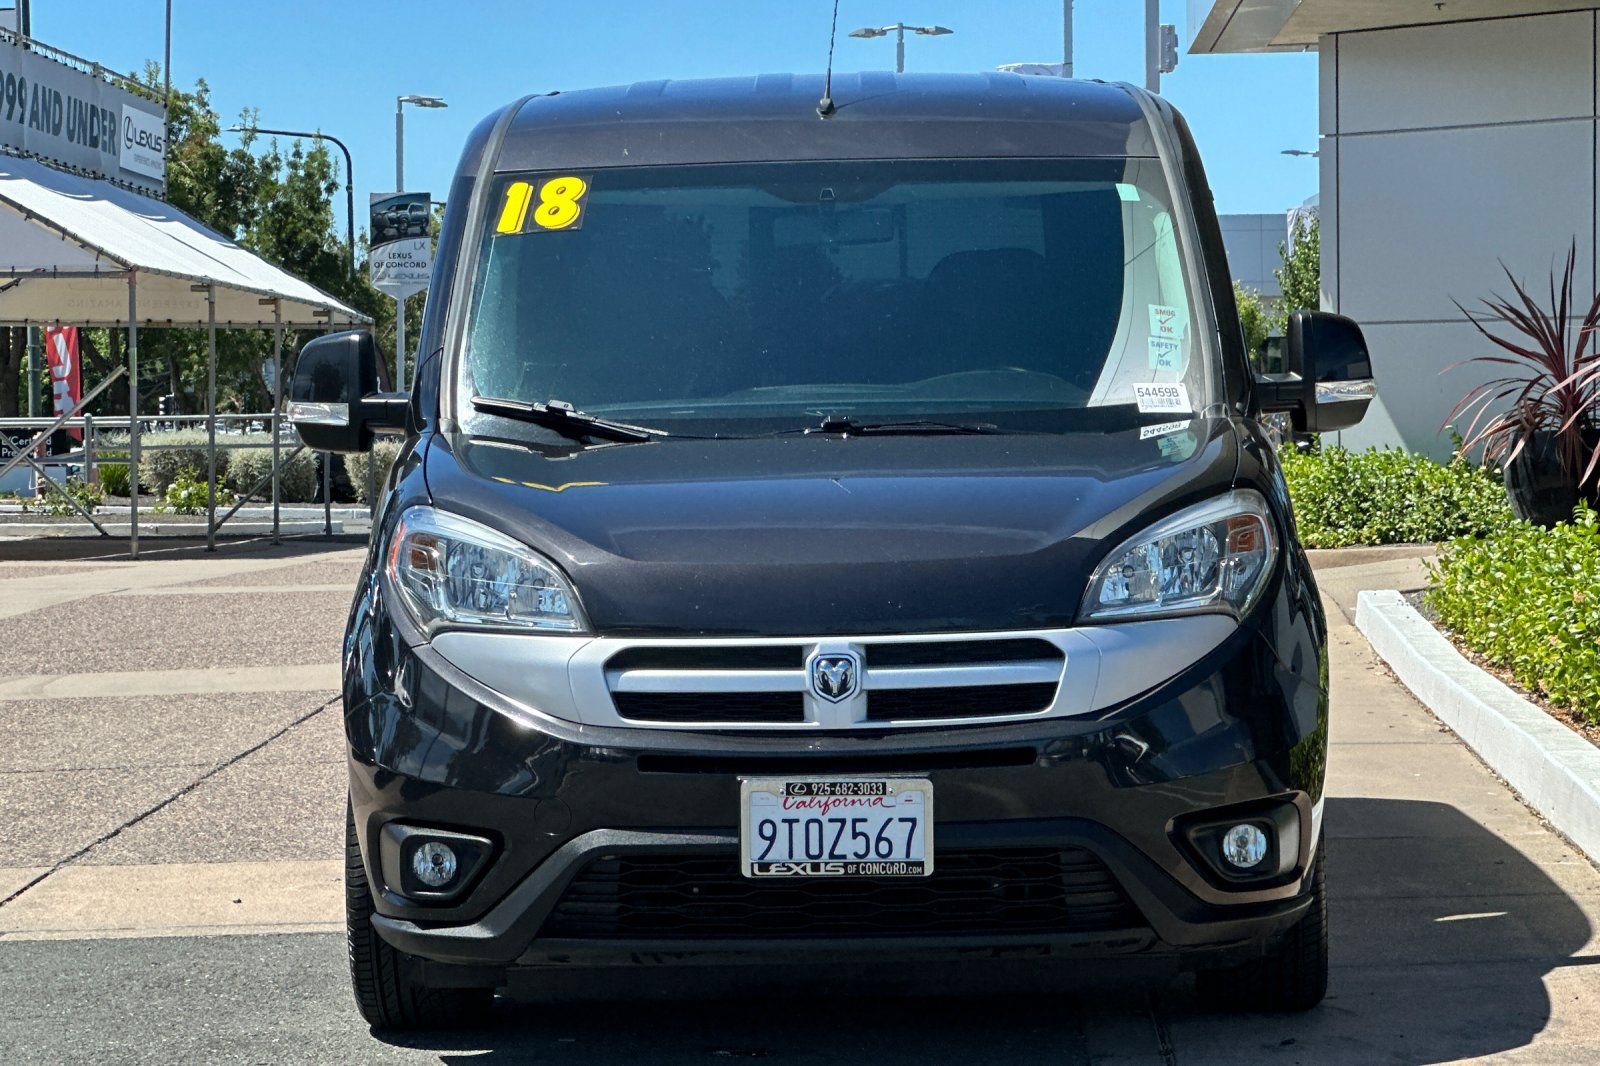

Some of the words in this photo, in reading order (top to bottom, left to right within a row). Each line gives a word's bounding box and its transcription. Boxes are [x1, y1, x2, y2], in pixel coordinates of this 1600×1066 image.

[29, 82, 62, 137] AND
[66, 95, 117, 156] UNDER
[133, 127, 164, 152] LEXUS
[496, 176, 587, 234] 18
[413, 241, 426, 250] LX
[388, 252, 413, 260] LEXUS
[386, 261, 427, 269] CONCORD
[1154, 308, 1176, 317] SMOG
[1160, 325, 1173, 333] OK
[1151, 341, 1178, 351] SAFETY
[1159, 359, 1171, 367] OK
[1137, 387, 1180, 398] 54459B
[811, 783, 883, 795] 925-682-3033
[783, 796, 896, 816] California
[753, 862, 845, 876] LEXUS
[847, 864, 858, 874] OF
